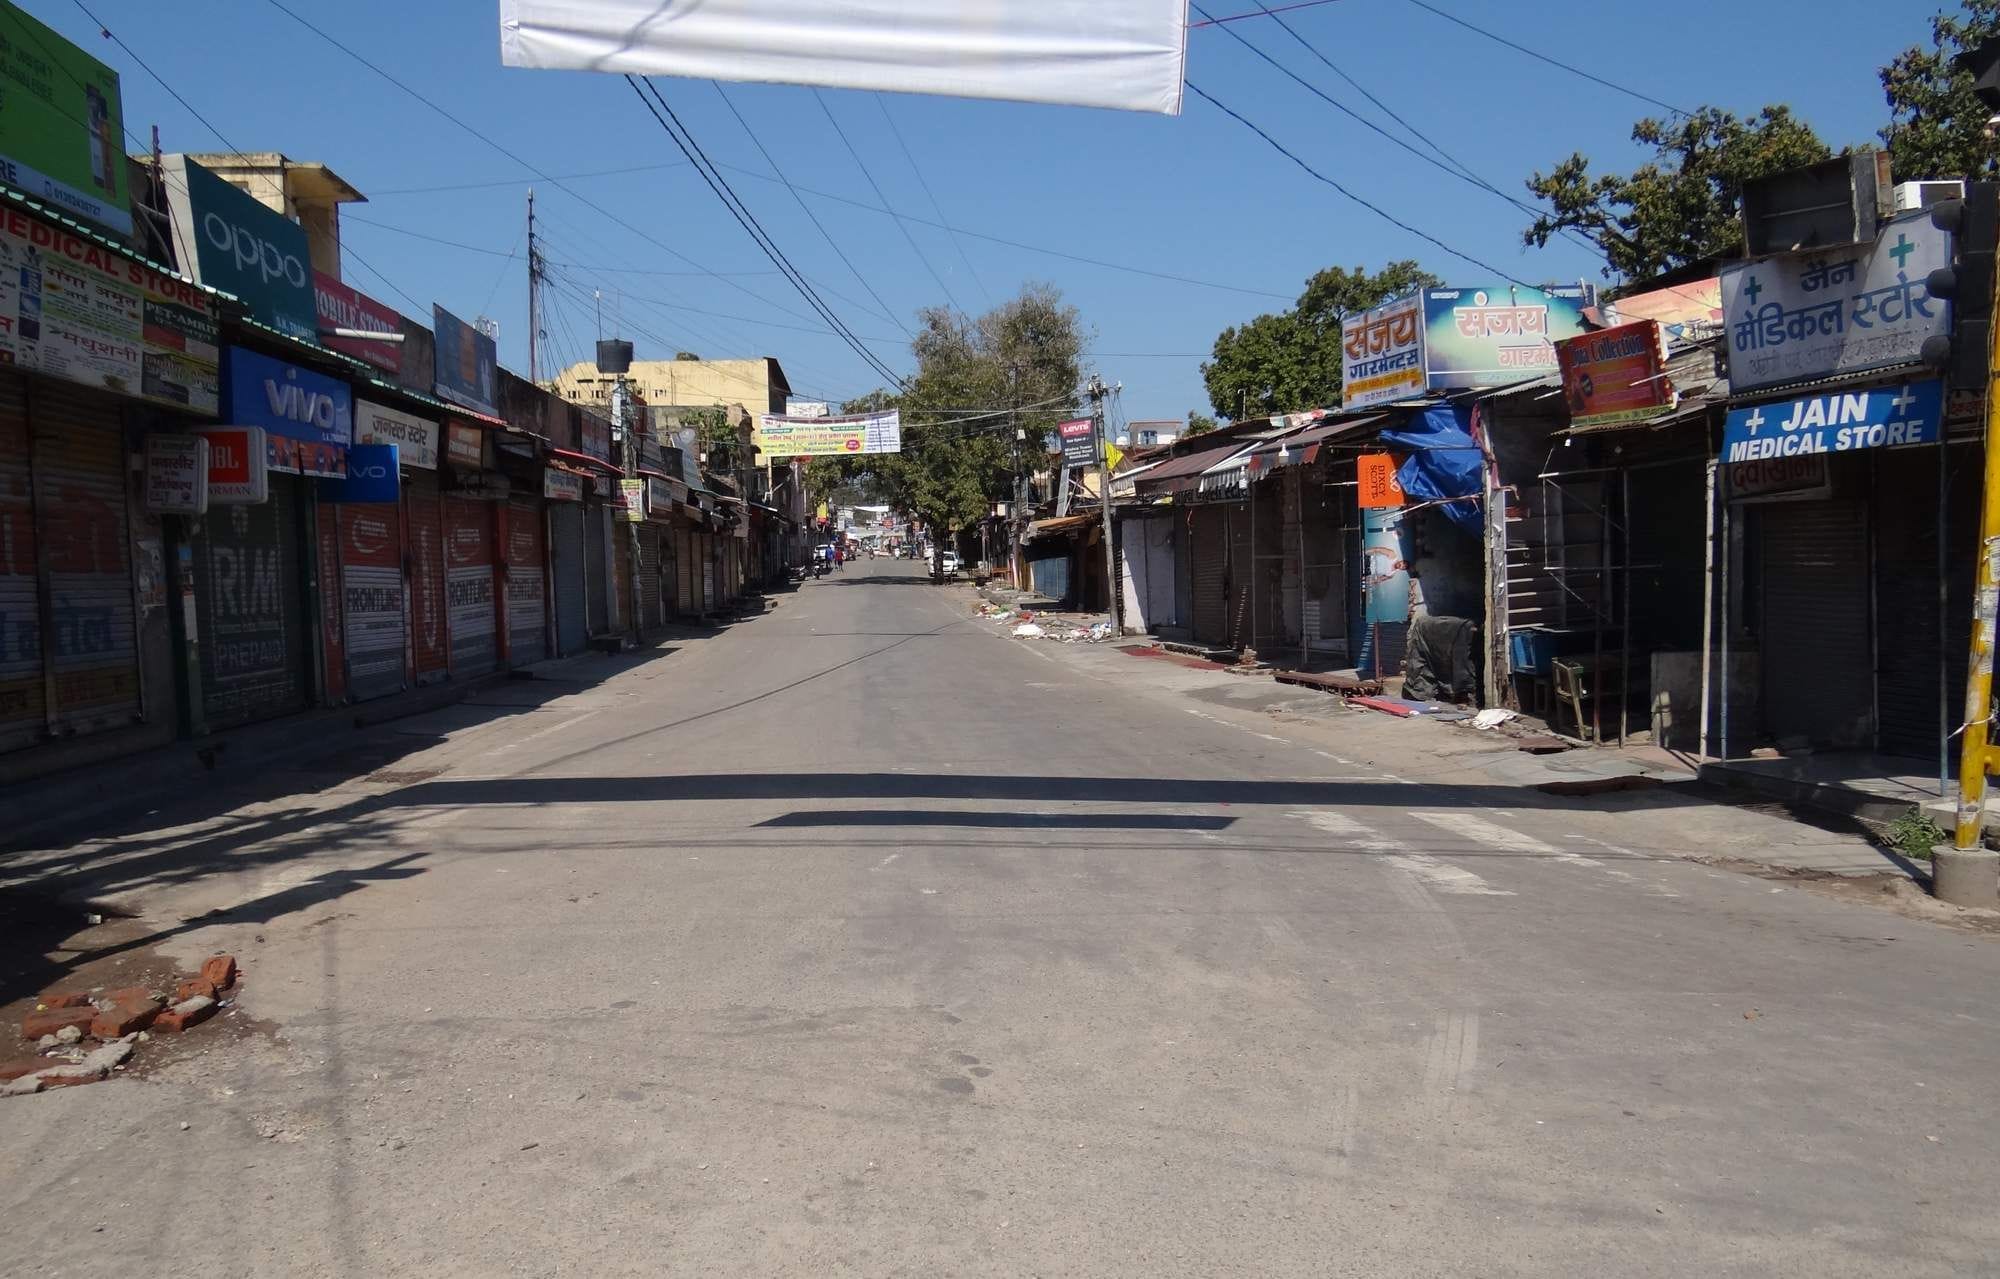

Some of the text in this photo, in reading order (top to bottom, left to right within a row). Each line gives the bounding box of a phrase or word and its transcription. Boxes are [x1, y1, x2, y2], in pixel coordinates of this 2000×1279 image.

[0, 207, 206, 310] EDICAL STORE
[1800, 259, 1859, 292] जैन
[315, 287, 358, 331] OBILE
[1453, 291, 1548, 338] संजय
[1734, 299, 1844, 352] मेडिकल
[1852, 271, 1937, 329] स्टोर
[1345, 307, 1418, 360] संजय
[1590, 331, 1645, 362] Collection
[264, 367, 336, 429] vivo
[1781, 392, 1870, 432] JAIN
[372, 414, 407, 441] जनरल
[407, 417, 428, 446] स्टोर
[1729, 419, 1924, 463] MEDICAL STORE
[1377, 465, 1386, 496] DIXCY
[214, 547, 281, 617] RIM
[449, 576, 491, 607] RONTLINE
